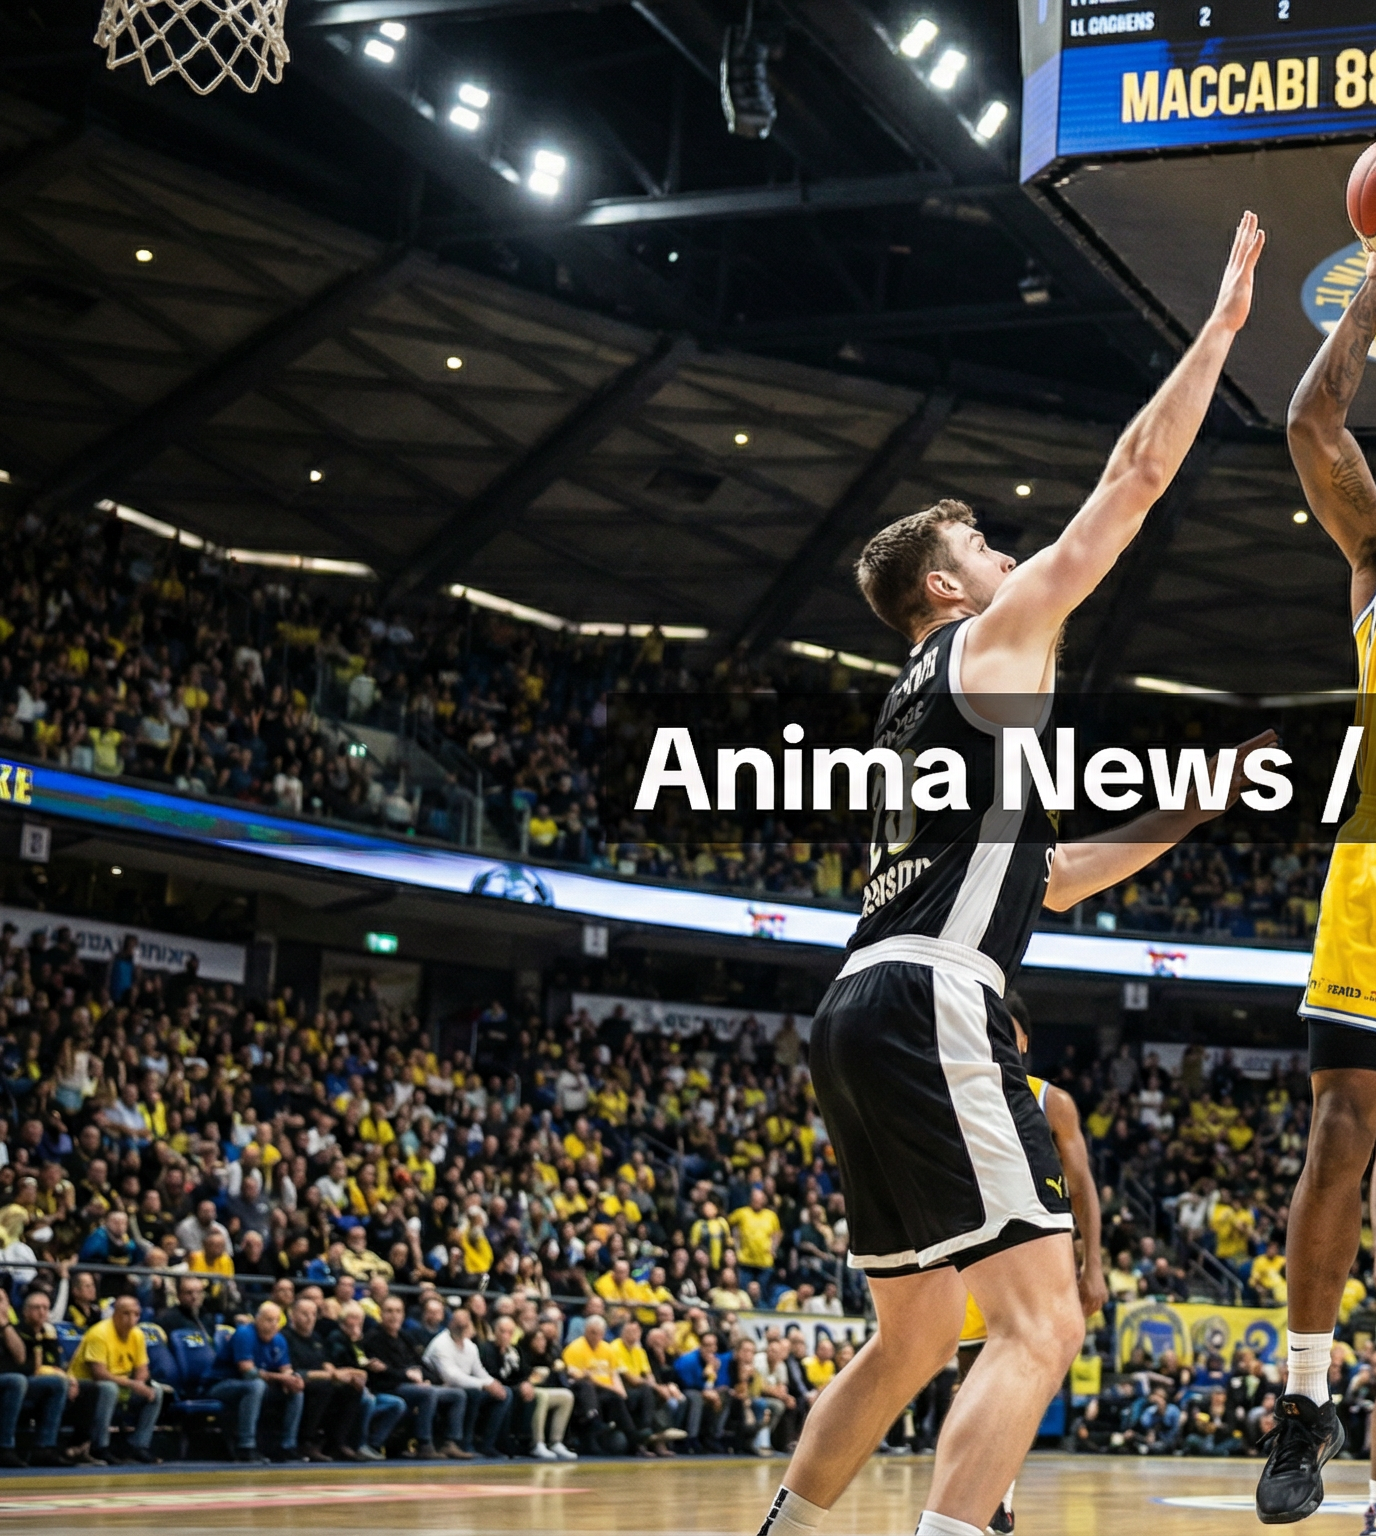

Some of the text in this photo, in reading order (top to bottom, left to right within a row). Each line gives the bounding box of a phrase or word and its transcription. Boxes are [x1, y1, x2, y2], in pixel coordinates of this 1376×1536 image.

[1199, 6, 1211, 27] 2
[1278, 0, 1290, 19] 2
[1121, 56, 1319, 123] MACCABI
